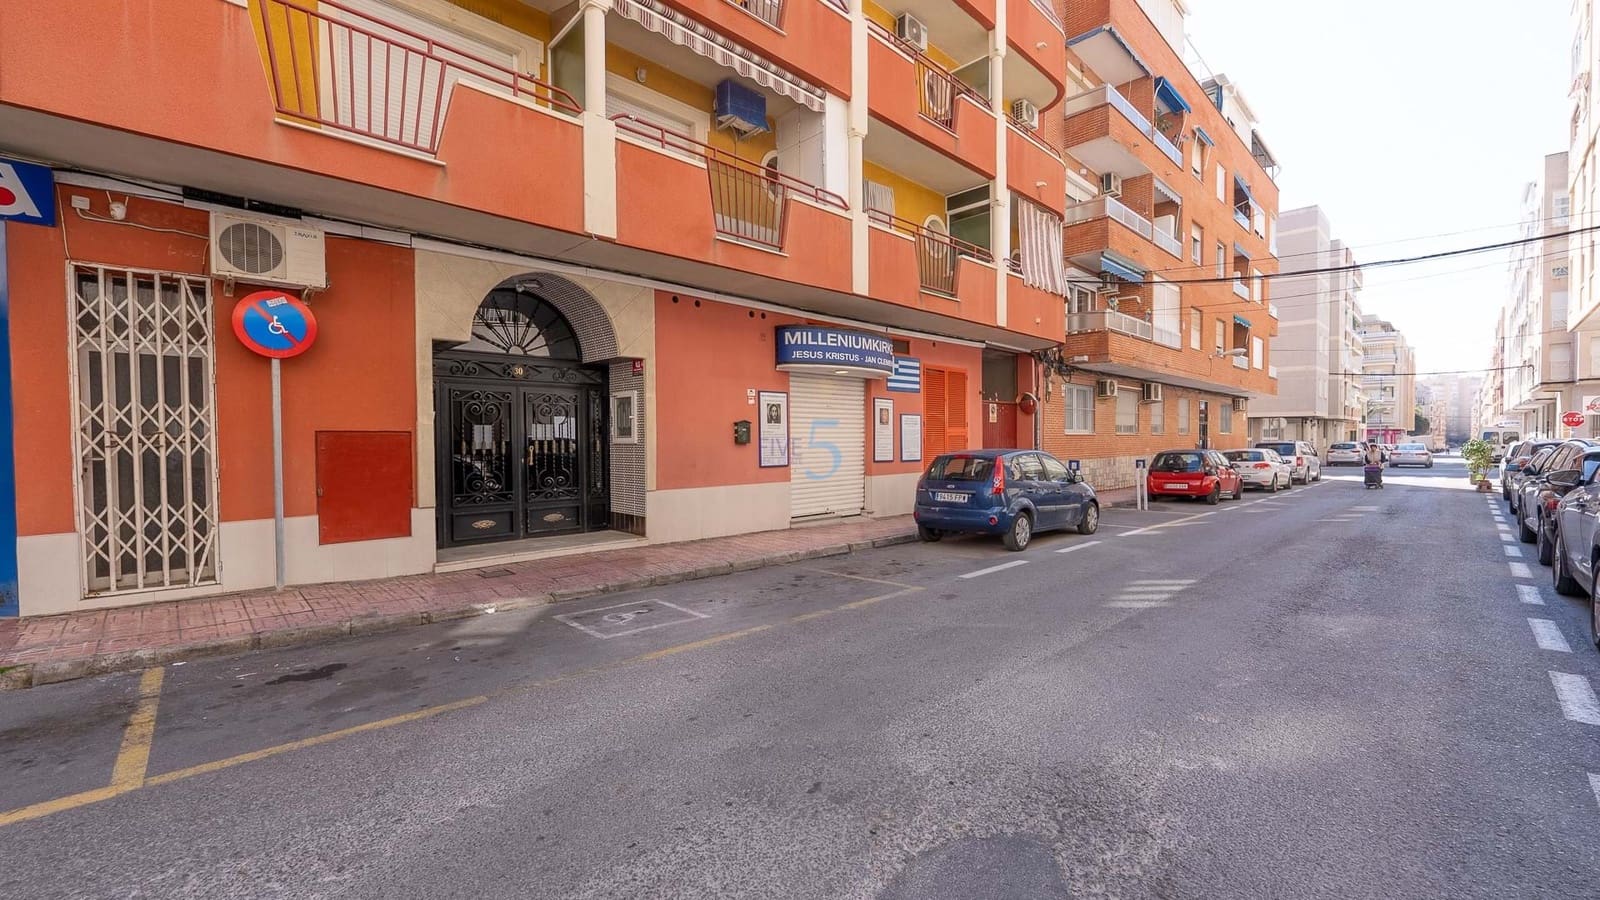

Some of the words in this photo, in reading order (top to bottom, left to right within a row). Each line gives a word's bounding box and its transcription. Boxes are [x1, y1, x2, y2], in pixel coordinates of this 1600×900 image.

[792, 350, 823, 359] JESUS
[826, 352, 859, 362] KRISTUS
[864, 356, 877, 364] JAN
[514, 367, 524, 375] 30
